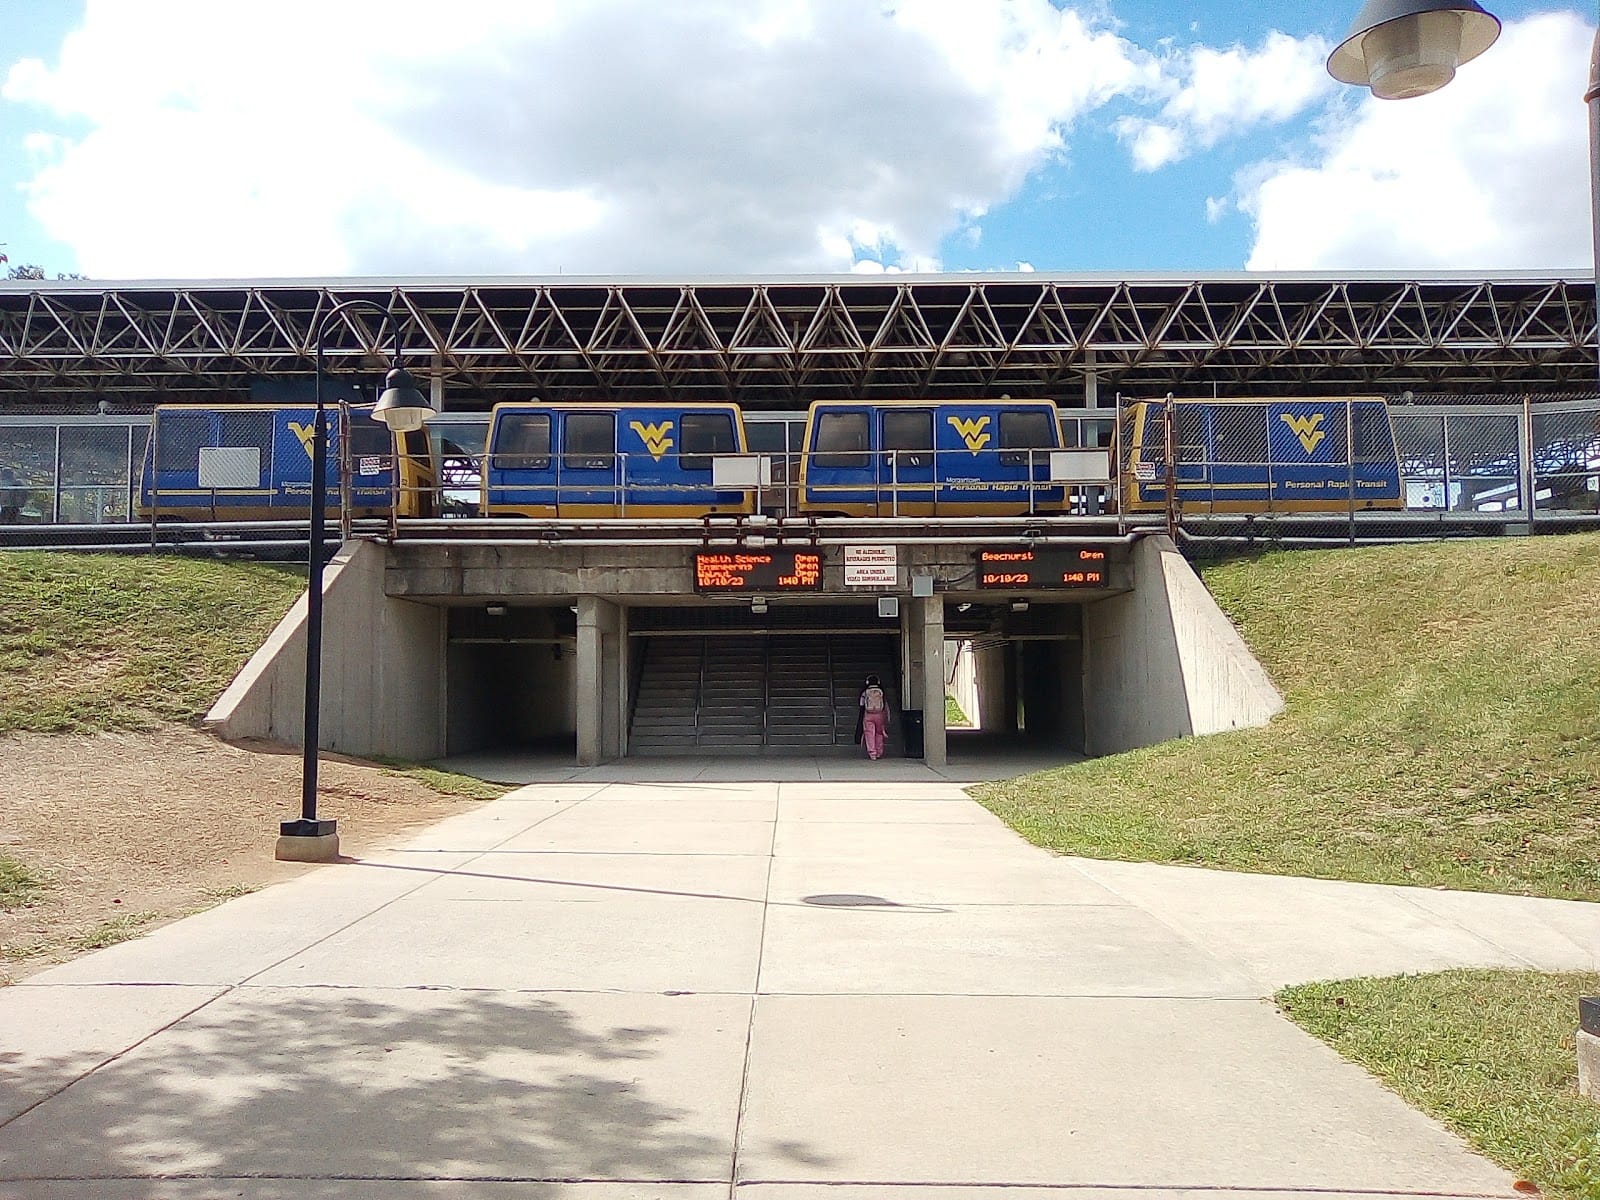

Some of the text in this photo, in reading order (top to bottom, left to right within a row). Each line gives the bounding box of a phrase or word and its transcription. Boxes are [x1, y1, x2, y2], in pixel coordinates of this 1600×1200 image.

[950, 483, 1052, 492] Personal Rapid Trnsit
[1285, 480, 1324, 488] Personal
[1356, 480, 1387, 488] Transit
[696, 554, 819, 563] Health Science Open
[981, 550, 1104, 560] Beechurst Open
[697, 562, 819, 571] Engineering Open
[794, 569, 819, 578] Open
[982, 573, 1100, 583] 10/10/23 1:40 PM
[698, 577, 815, 586] 10/10/23 1:40 PM
